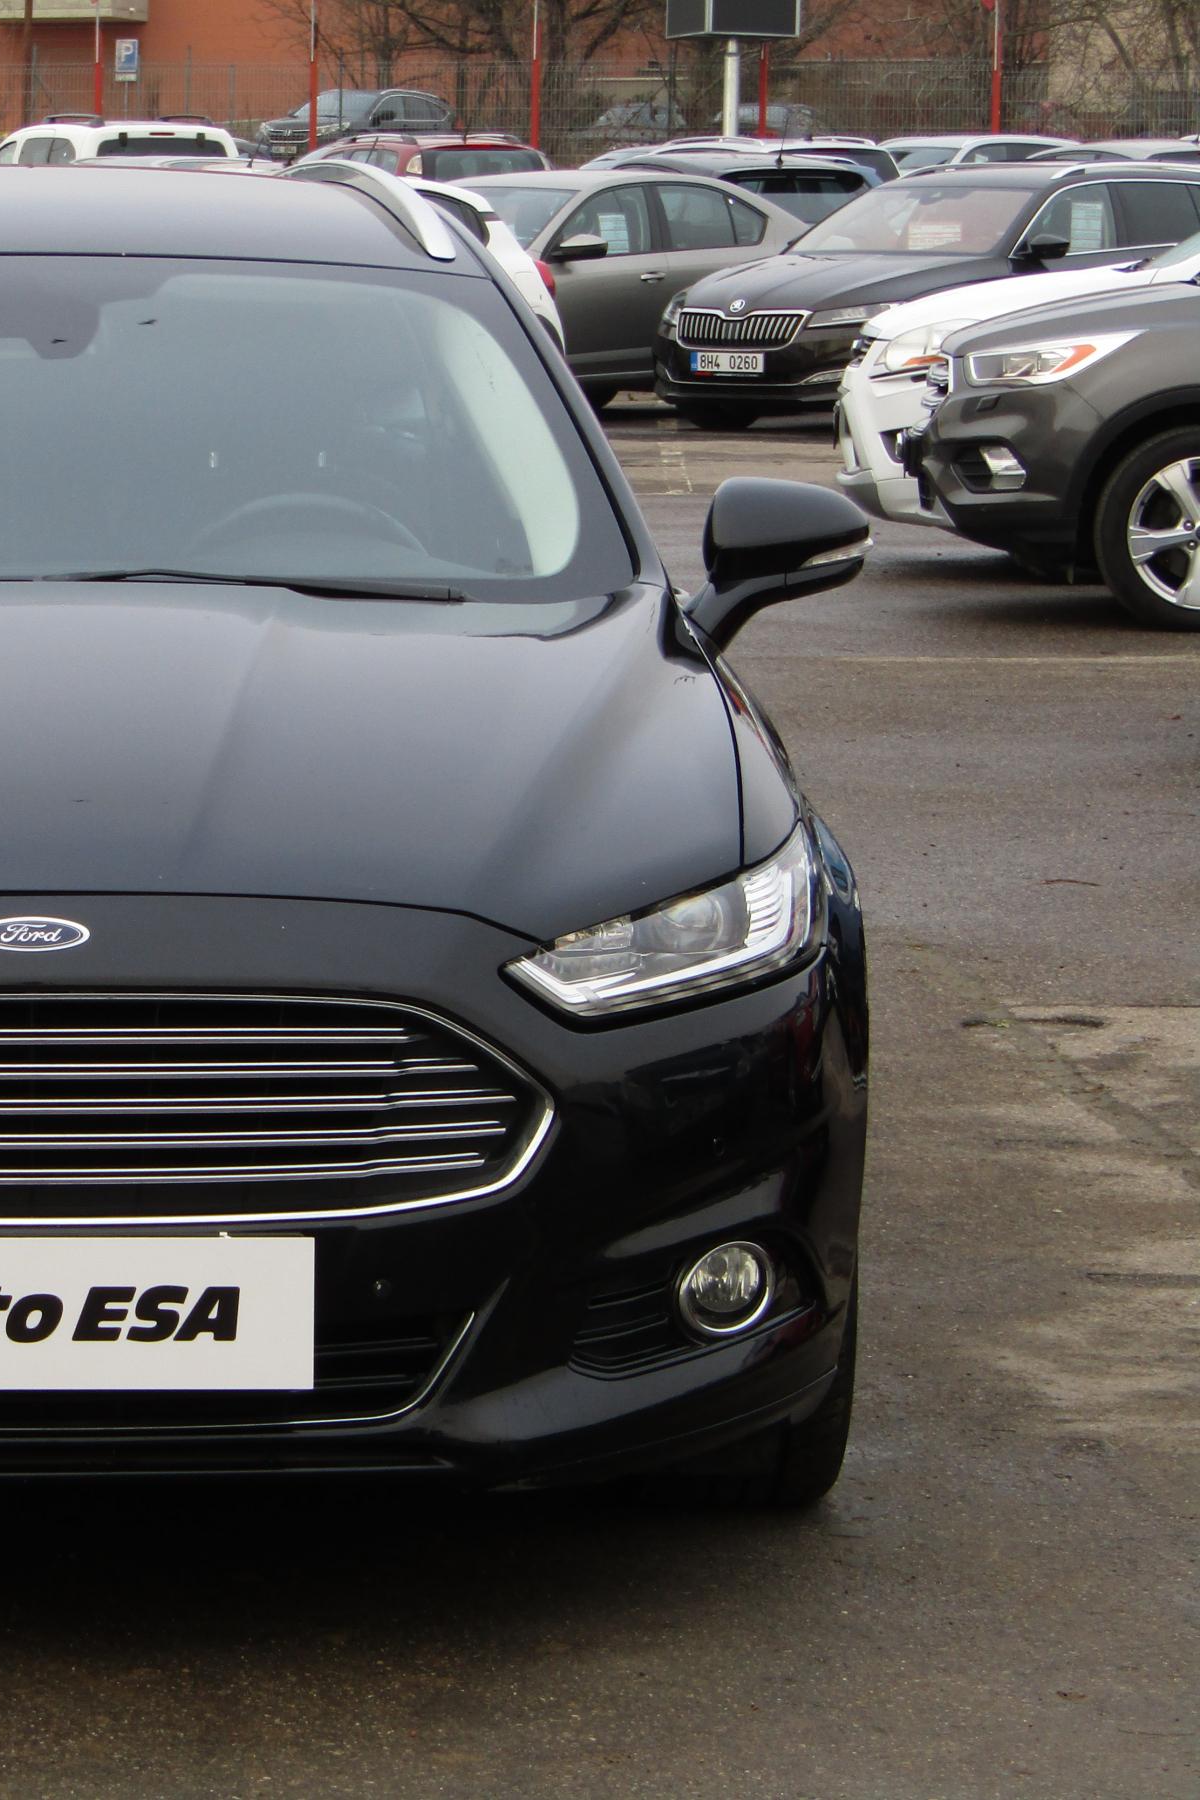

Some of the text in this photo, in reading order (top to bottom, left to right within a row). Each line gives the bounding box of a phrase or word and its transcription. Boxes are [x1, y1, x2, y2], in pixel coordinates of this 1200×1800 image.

[120, 43, 134, 62] P
[700, 354, 758, 370] 8H4 0260
[0, 923, 63, 942] Ford
[72, 1285, 241, 1343] ESA
